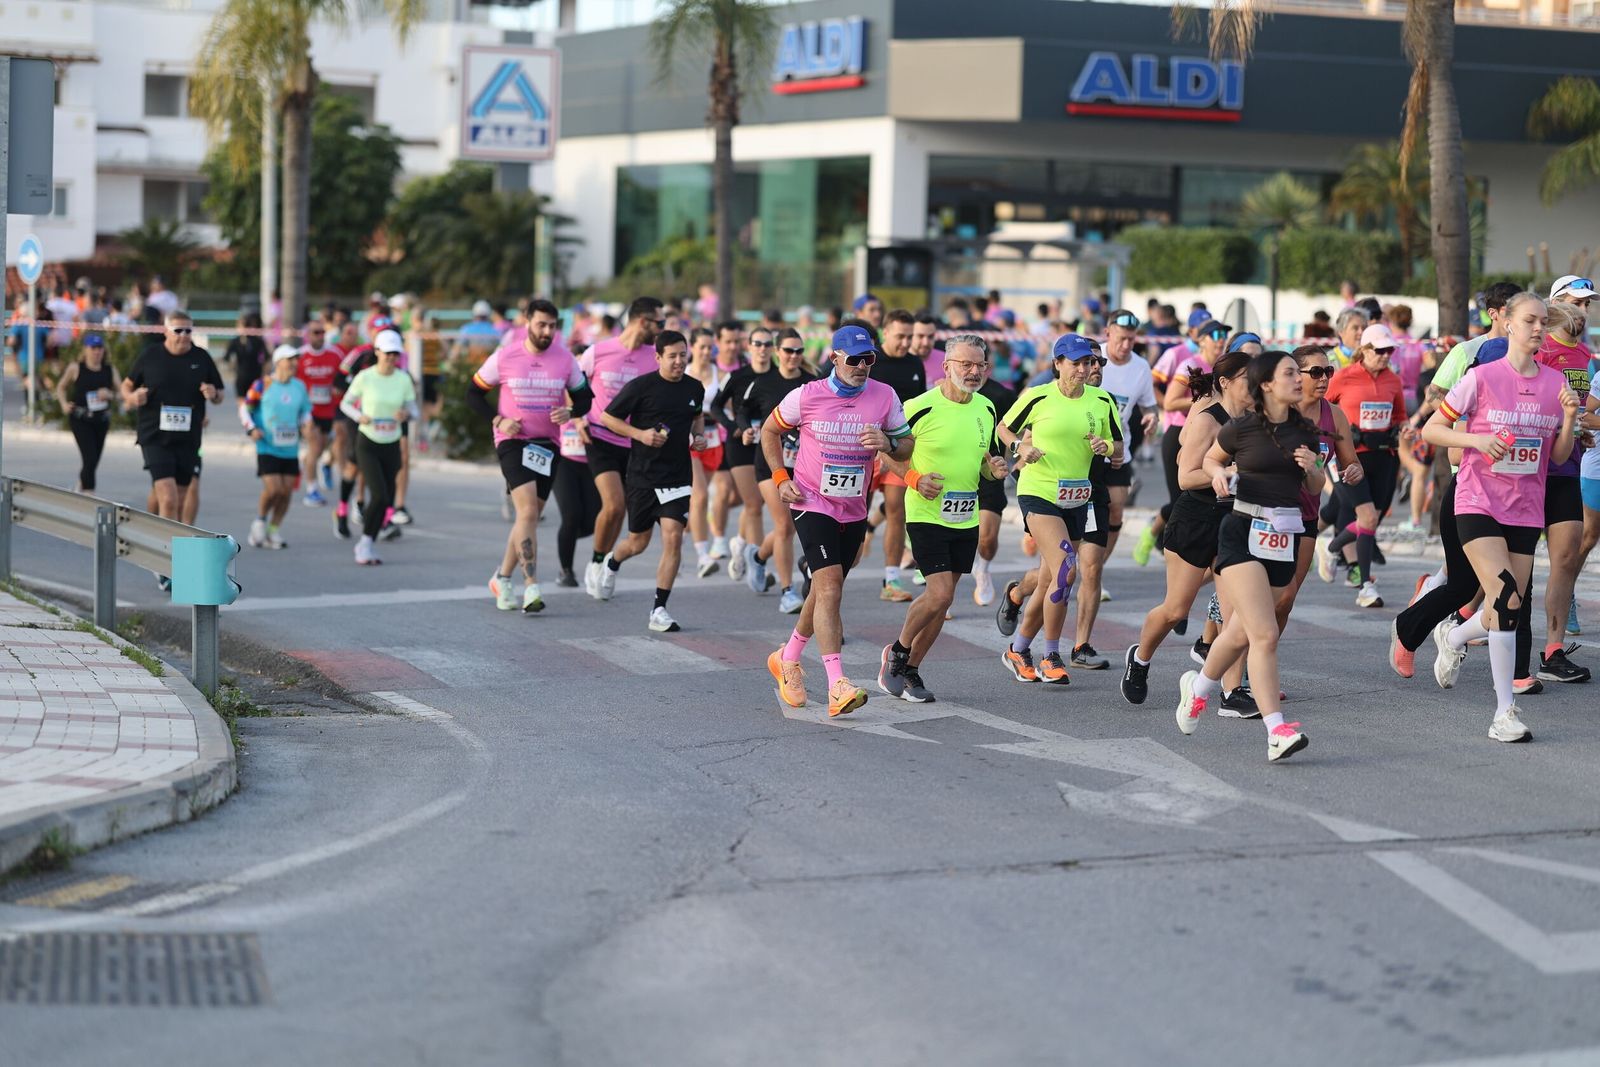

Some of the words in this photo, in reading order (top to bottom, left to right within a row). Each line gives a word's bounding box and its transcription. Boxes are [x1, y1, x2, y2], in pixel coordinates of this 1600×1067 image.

[772, 15, 869, 81] ALDI
[1070, 51, 1245, 110] ALDI
[472, 124, 544, 148] ALDI
[1515, 402, 1541, 412] XXXVI
[837, 413, 862, 422] XXXVI
[1363, 410, 1389, 420] 2241
[1487, 409, 1518, 425] MEDIA
[1519, 412, 1559, 429] MARATÓN
[811, 420, 840, 434] MEDIA
[841, 421, 882, 434] MARTÓN
[815, 432, 861, 444] INTERNACIONA
[527, 451, 547, 466] 273
[1500, 448, 1538, 462] 196
[829, 474, 857, 487] 571
[1058, 487, 1090, 500] 2123
[943, 500, 975, 512] 2122
[1258, 532, 1289, 549] 780
